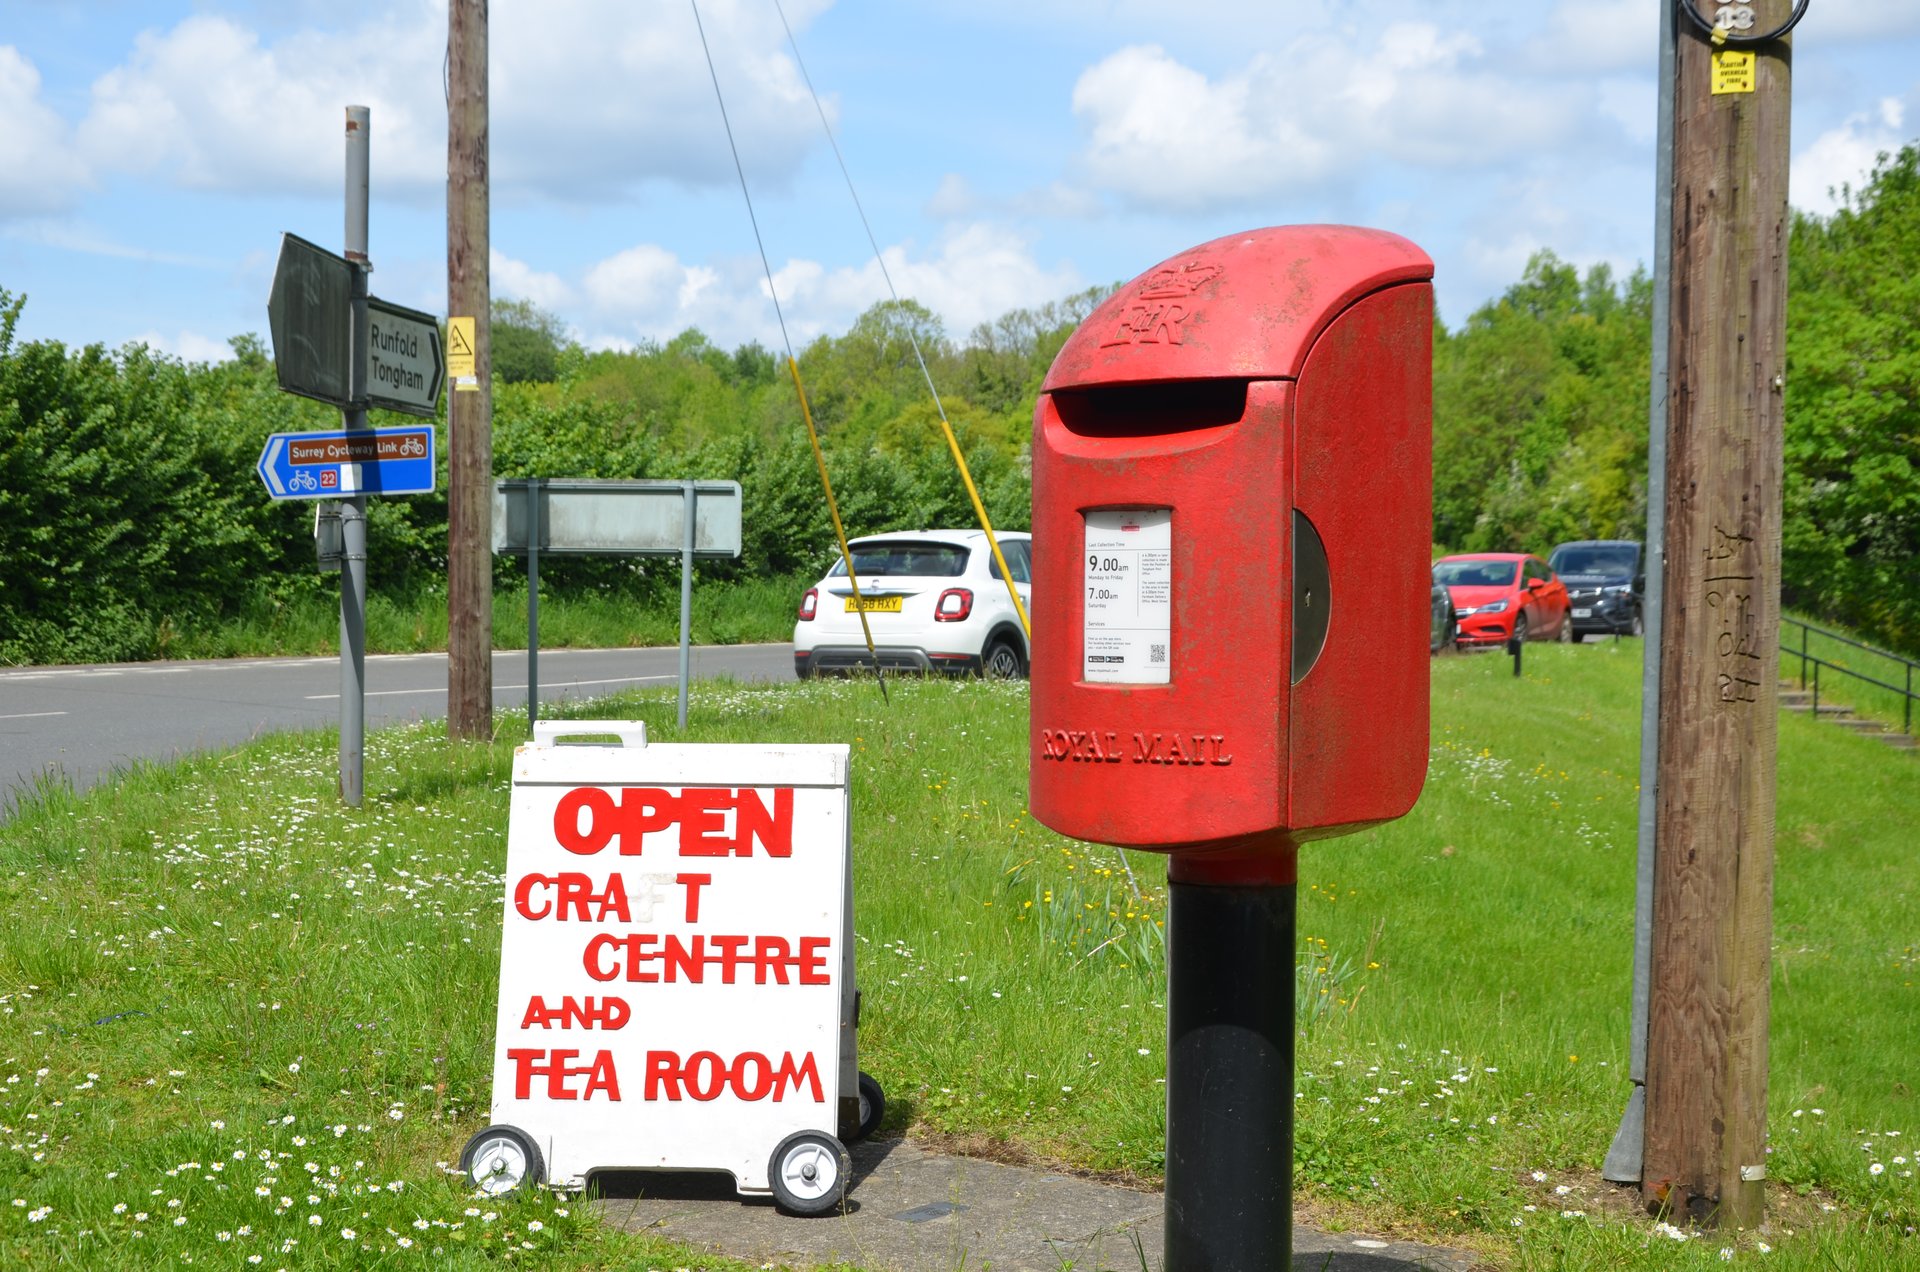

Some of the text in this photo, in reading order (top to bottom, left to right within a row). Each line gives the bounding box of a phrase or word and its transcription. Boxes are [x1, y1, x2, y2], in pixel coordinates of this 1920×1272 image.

[371, 323, 418, 359] Runfold
[371, 355, 424, 391] Tongham
[292, 442, 398, 459] Surrey Cycleway Link
[321, 473, 336, 485] 22
[1089, 555, 1129, 572] 9.00am
[849, 598, 898, 609] H68 HXY
[1088, 587, 1119, 600] 7.00am
[1042, 729, 1232, 766] ROYAL MAIL
[553, 786, 794, 857] OPEN
[582, 932, 831, 985] CENTRE
[520, 995, 631, 1030] AND
[506, 1047, 826, 1103] TEA ROOM
